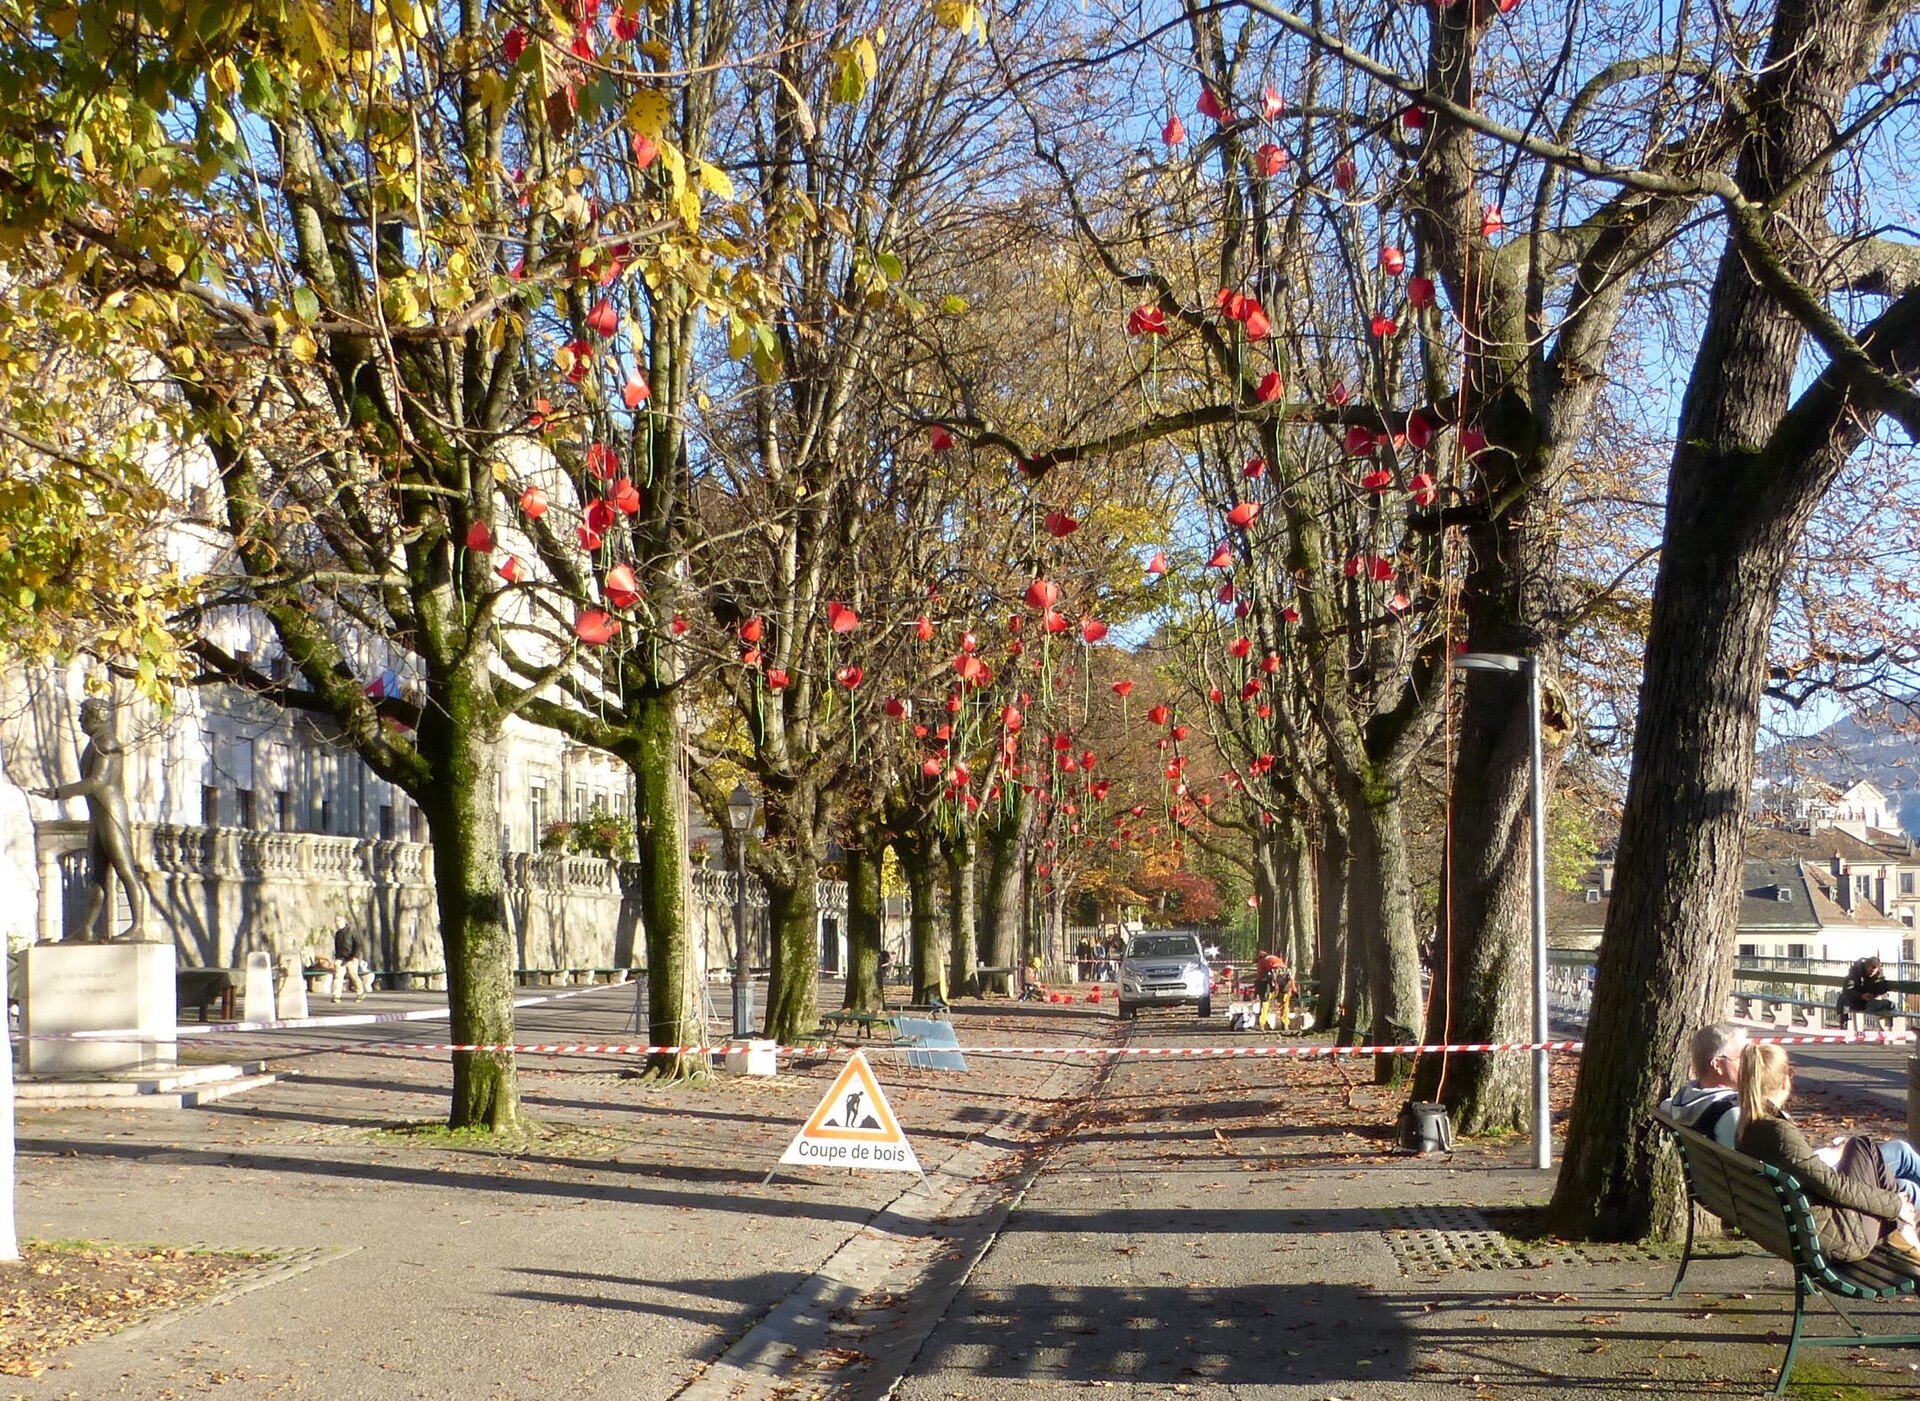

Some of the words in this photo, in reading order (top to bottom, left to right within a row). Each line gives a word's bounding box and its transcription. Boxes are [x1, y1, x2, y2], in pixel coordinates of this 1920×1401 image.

[798, 1141, 847, 1161] Coupe
[851, 1144, 869, 1160] de
[874, 1145, 905, 1162] bois
